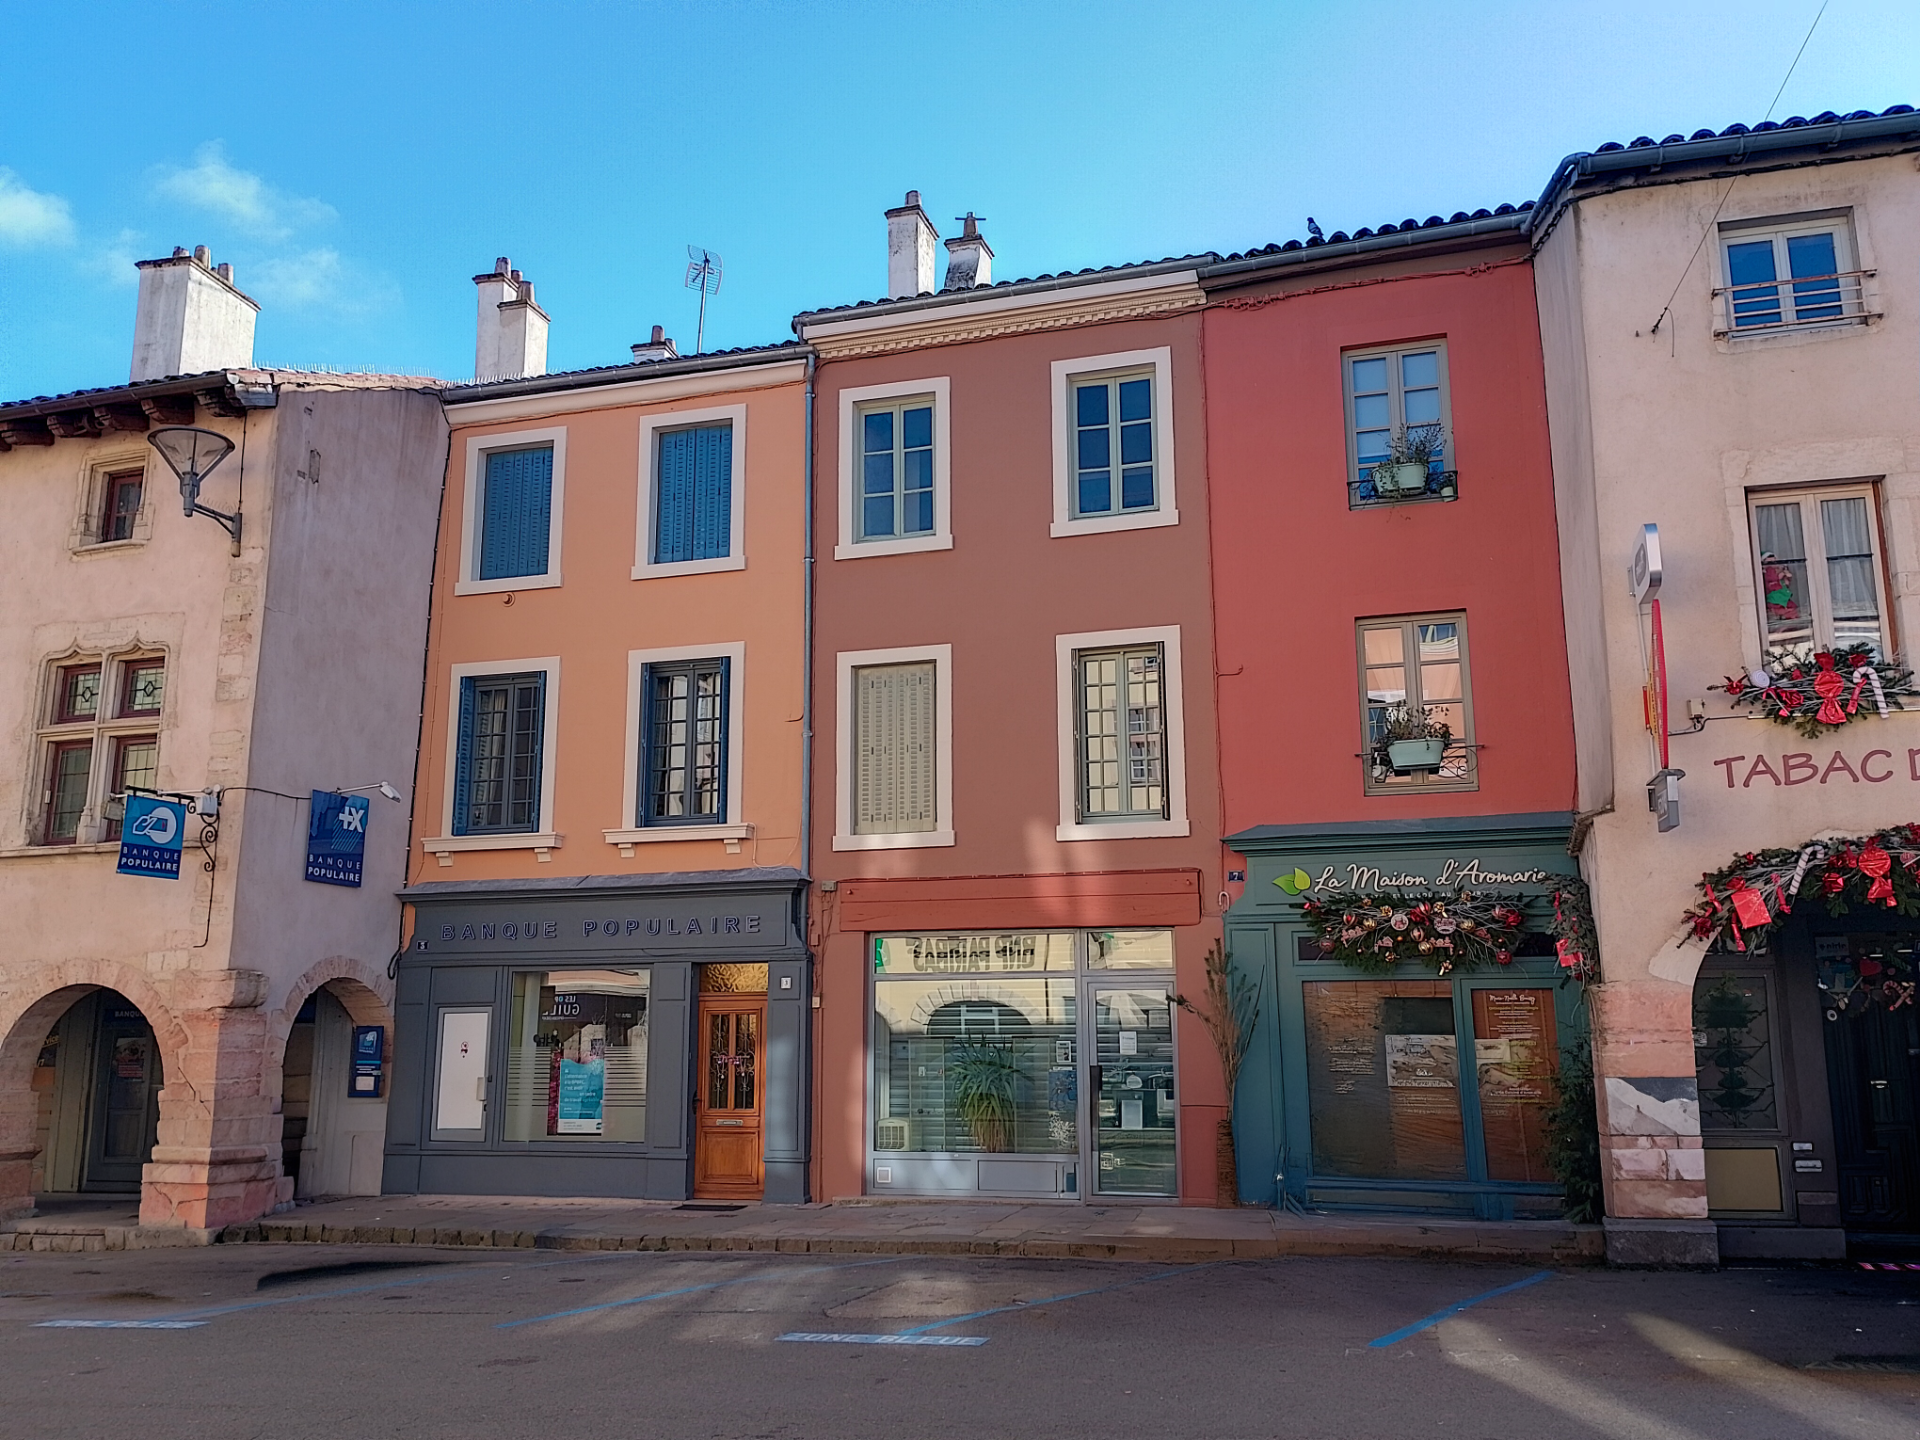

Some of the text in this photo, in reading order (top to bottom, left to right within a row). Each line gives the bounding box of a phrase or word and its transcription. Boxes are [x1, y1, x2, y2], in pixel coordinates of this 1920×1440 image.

[1713, 750, 1894, 789] TABAC
[122, 846, 179, 860] BANQUE
[121, 857, 178, 871] POPULAIRE
[309, 854, 361, 870] BANQUE
[308, 866, 360, 882] POPULAIRE
[1315, 858, 1546, 893] La Maison d'Aromarie
[441, 915, 760, 941] BANQUE POPULAIRE
[115, 1010, 143, 1018] BANQU
